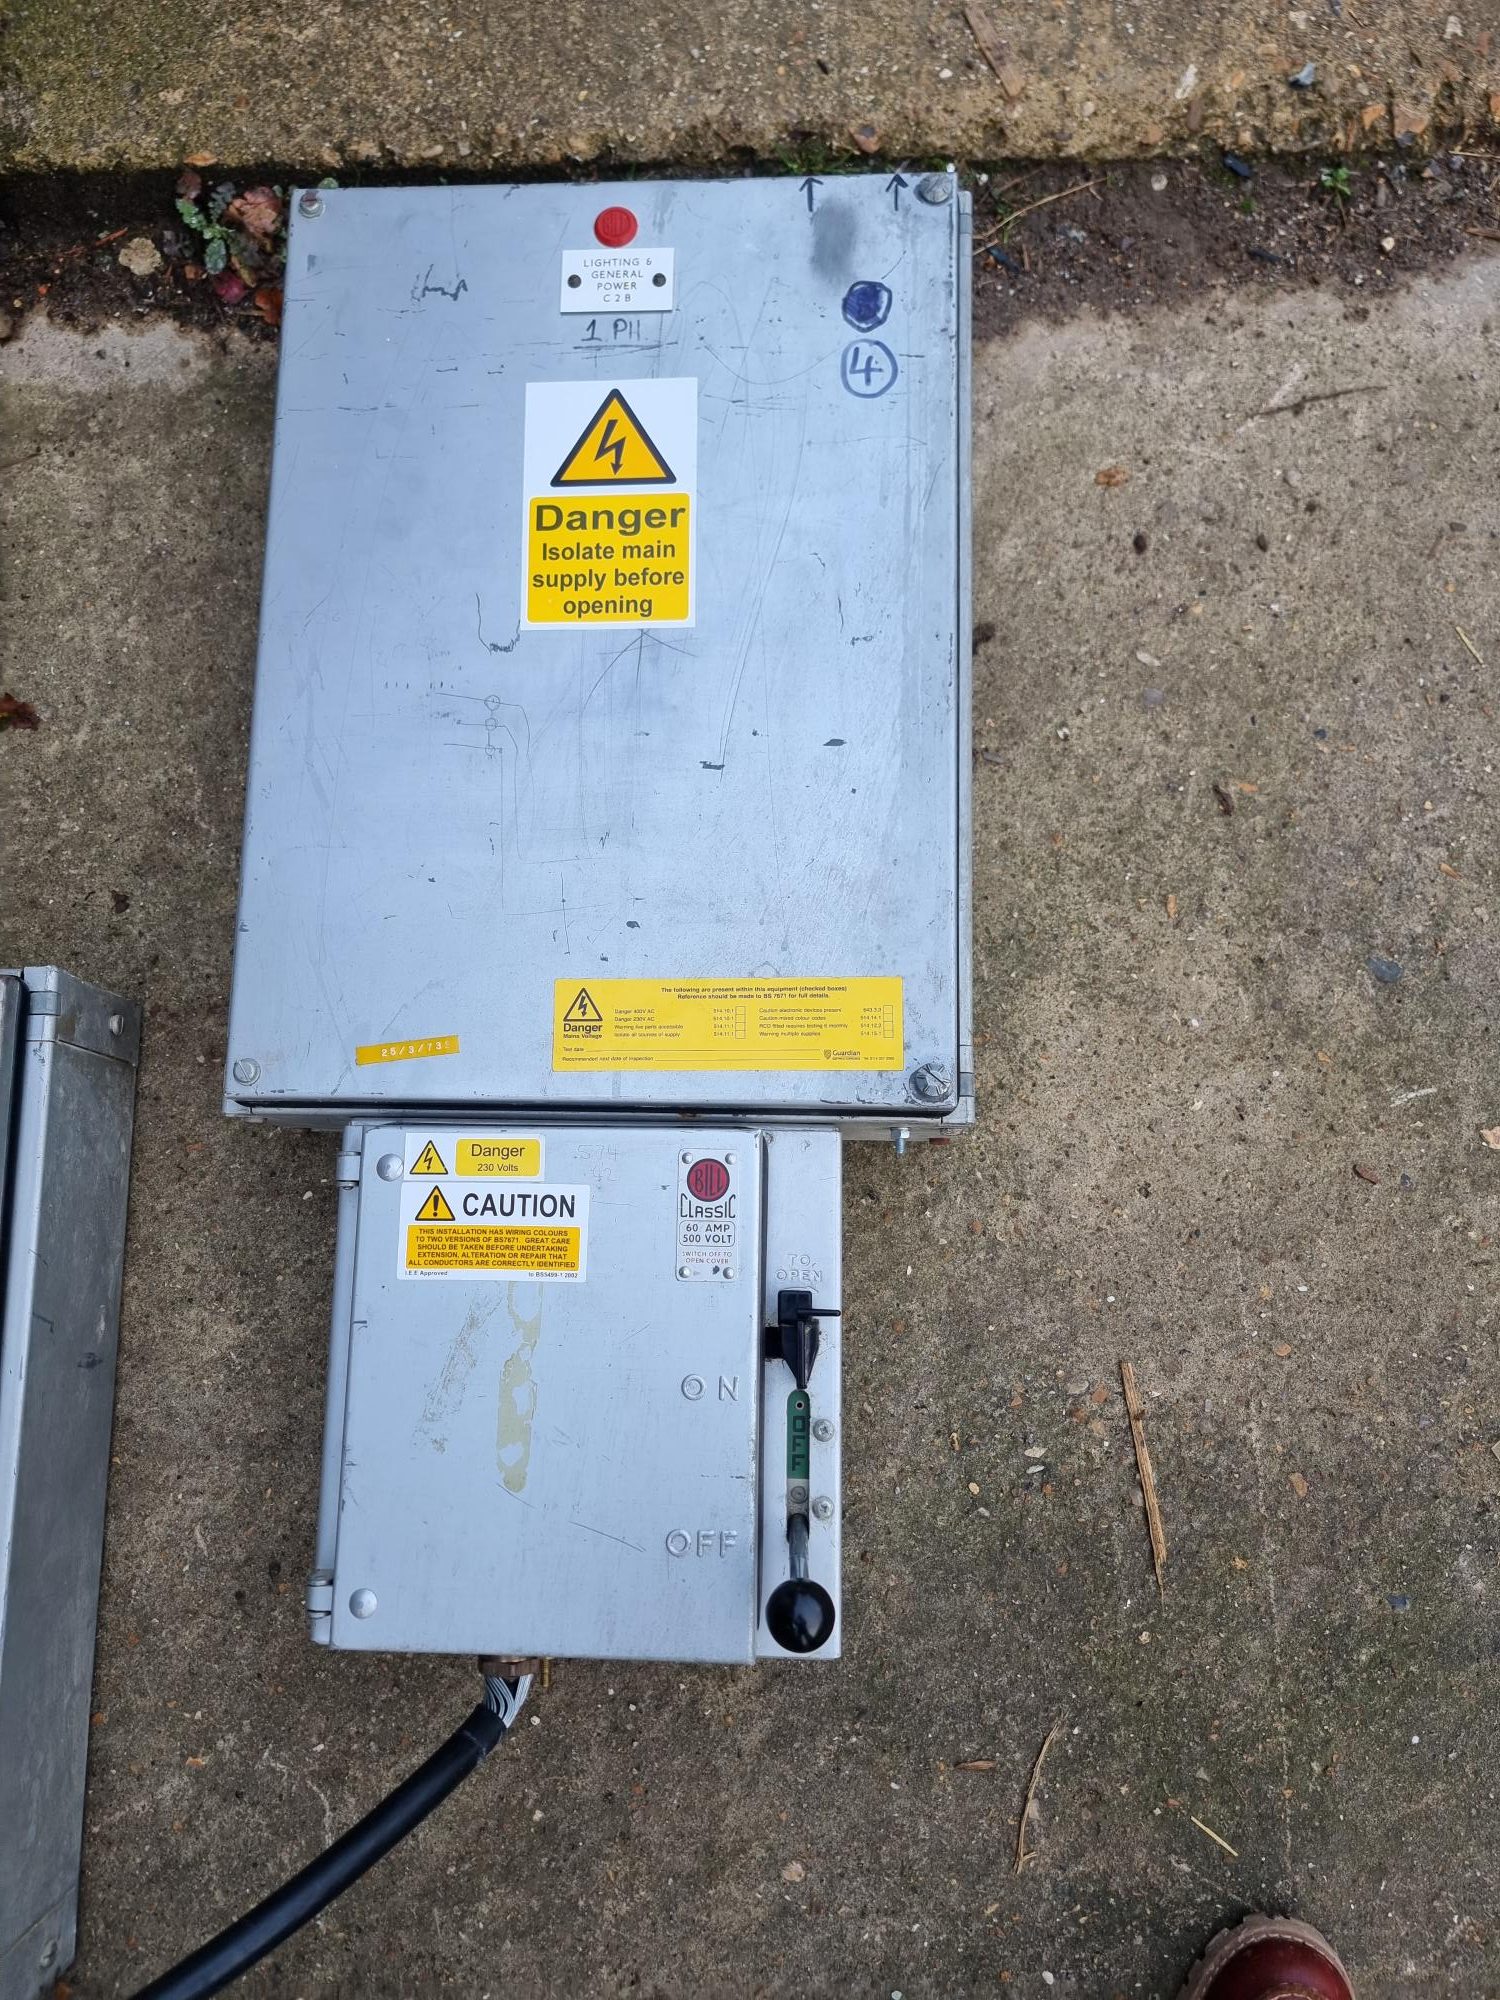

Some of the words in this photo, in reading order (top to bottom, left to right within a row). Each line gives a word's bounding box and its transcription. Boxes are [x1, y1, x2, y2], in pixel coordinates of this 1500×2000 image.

[583, 257, 640, 268] LIGHTING
[591, 270, 644, 280] GENERAL
[597, 282, 637, 291] POWER
[535, 504, 686, 536] Danger
[541, 540, 614, 560] Isolate
[622, 540, 677, 559] main
[532, 567, 607, 592] supply
[613, 565, 685, 587] before
[562, 593, 653, 618] opening
[563, 1023, 603, 1034] Danger
[471, 1144, 525, 1160] Danger
[477, 1164, 494, 1172] 230
[497, 1163, 519, 1172] Volts
[695, 1163, 724, 1196] BILL
[463, 1193, 575, 1218] CAUTION
[680, 1192, 737, 1219] CLASSIC
[686, 1223, 699, 1232] 60
[705, 1223, 730, 1233] AMP
[683, 1234, 701, 1243] 500
[704, 1234, 733, 1244] VOLT
[788, 1254, 811, 1267] TO
[776, 1269, 823, 1283] OPEN
[681, 1373, 740, 1402] ON
[792, 1415, 807, 1472] OFF
[665, 1528, 738, 1558] OFF
